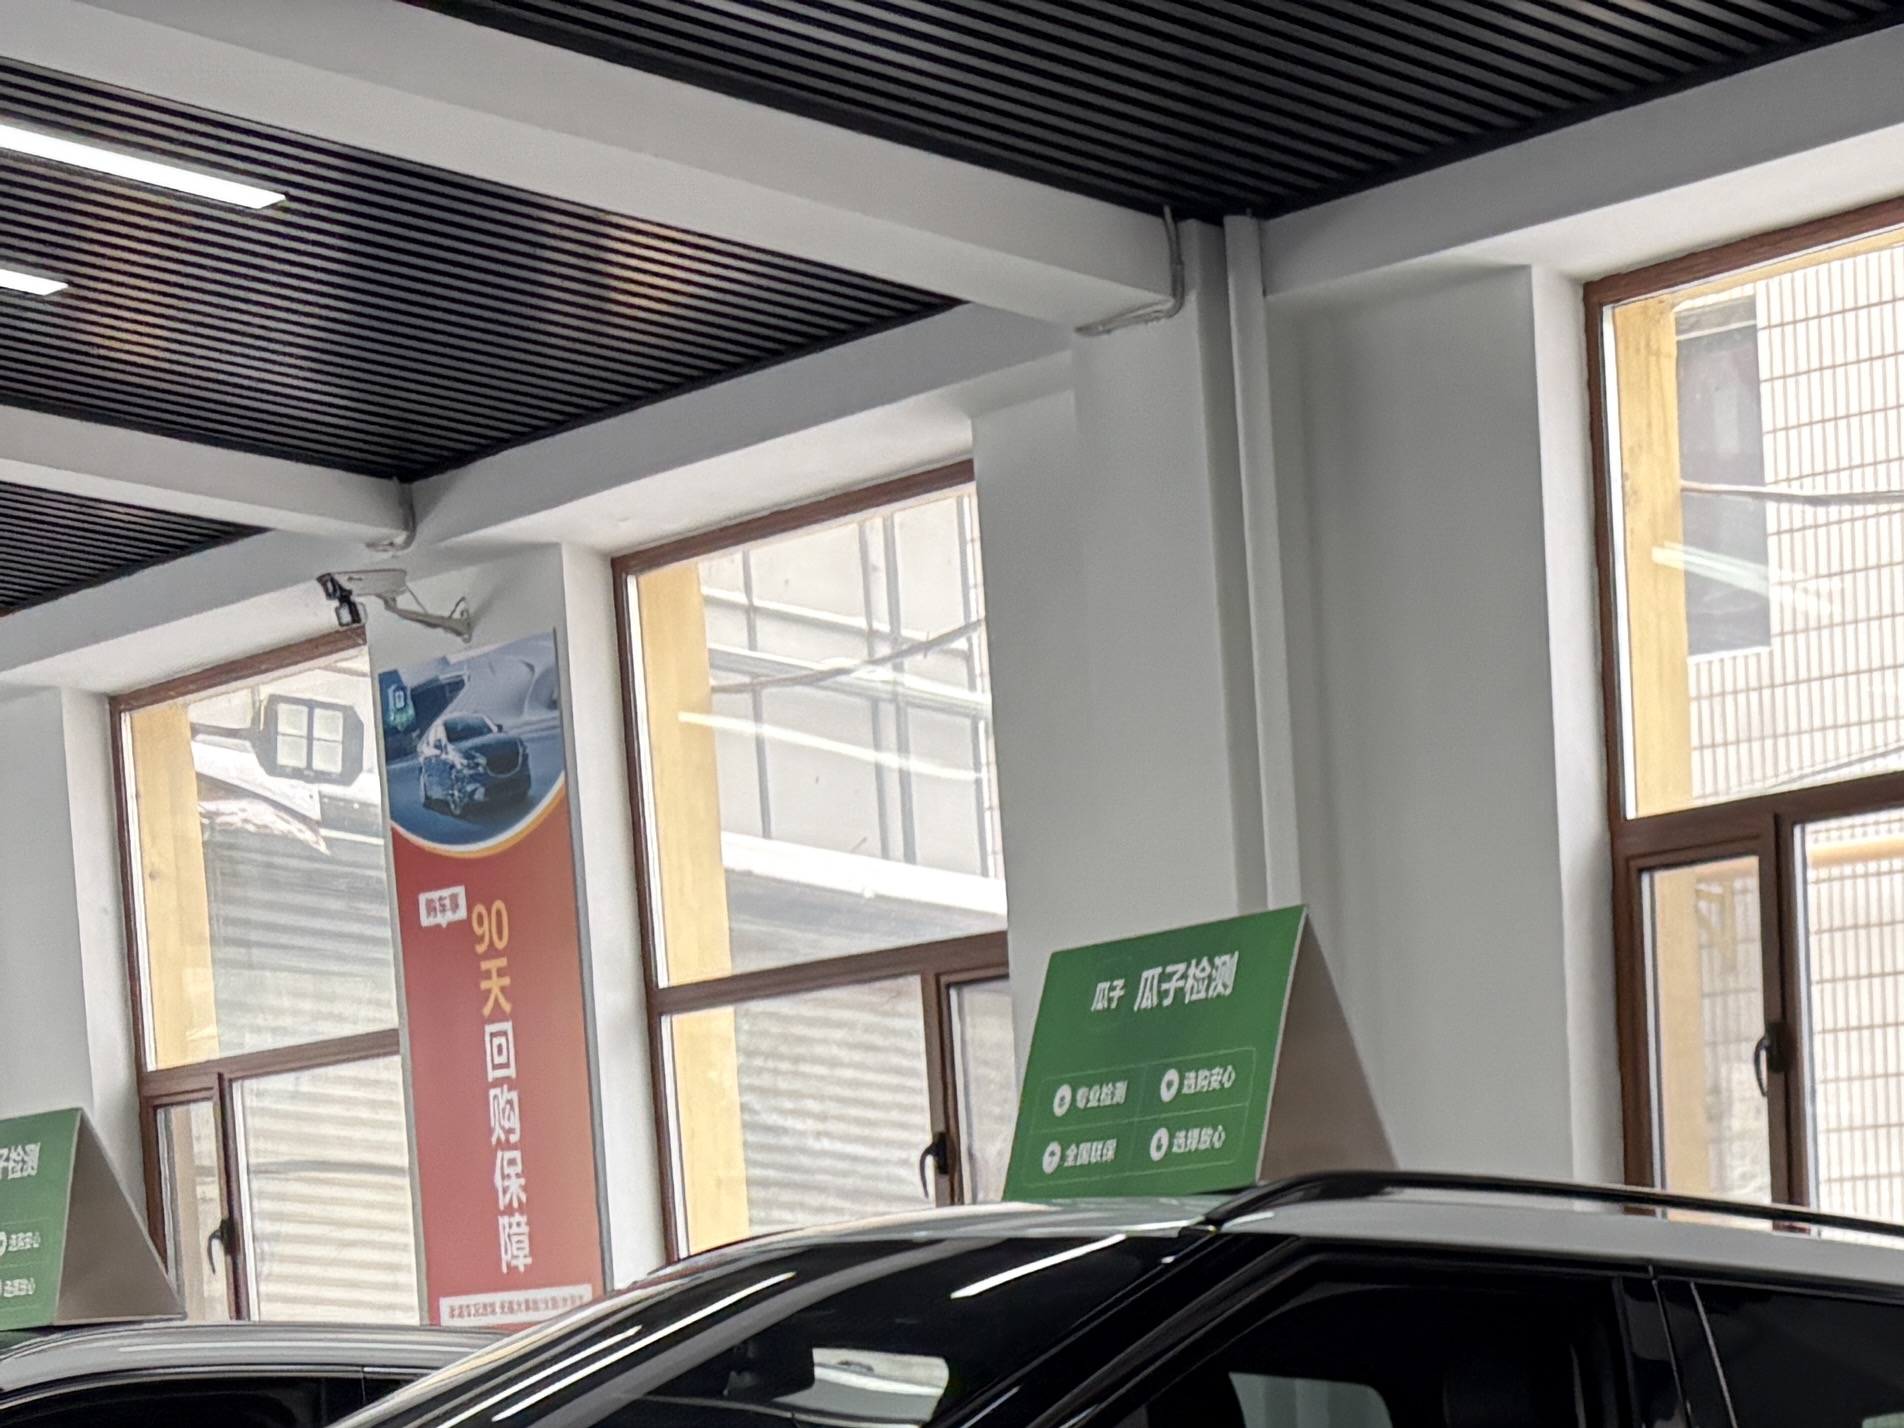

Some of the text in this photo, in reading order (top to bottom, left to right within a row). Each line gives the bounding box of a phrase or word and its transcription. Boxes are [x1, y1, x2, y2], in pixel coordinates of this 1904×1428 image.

[472, 899, 533, 1274] 90天回购保障
[1091, 951, 1239, 1012] 瓜子 瓜子检测
